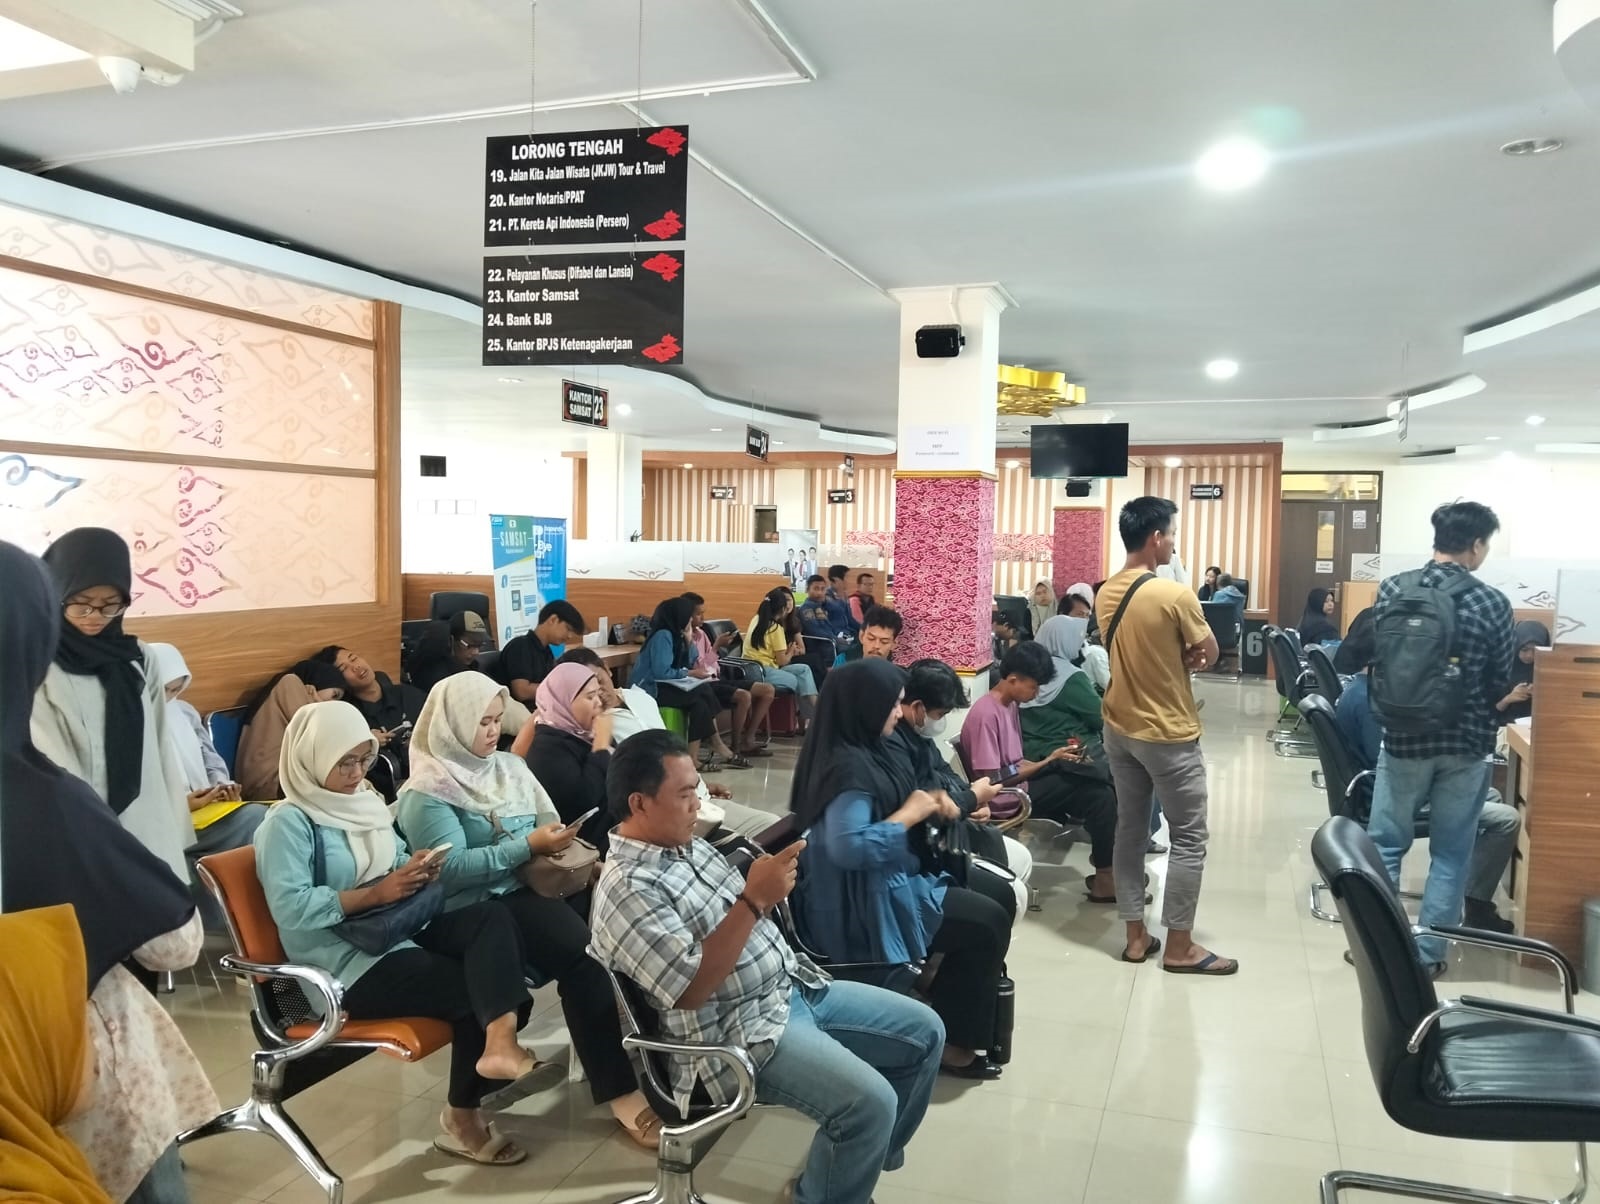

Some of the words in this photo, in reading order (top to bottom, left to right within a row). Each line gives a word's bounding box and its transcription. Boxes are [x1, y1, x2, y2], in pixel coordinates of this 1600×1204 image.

[512, 143, 565, 160] LORONG
[569, 139, 623, 157] TENGAH
[490, 169, 507, 182] 19.
[509, 168, 528, 182] Jalan
[529, 167, 544, 181] Kita
[545, 166, 564, 180] Jalan
[565, 165, 590, 179] Wisata
[591, 163, 617, 181] (JKJW)
[618, 162, 634, 176] Tour
[635, 161, 642, 175] &
[643, 160, 666, 175] Travel
[489, 194, 507, 207] 20.
[508, 193, 534, 206] Kantor
[536, 190, 585, 205] Notaris/PPAT
[489, 218, 506, 232] 21.
[508, 218, 519, 231] PT.
[520, 217, 545, 230] Kereta
[546, 216, 558, 233] Api
[559, 215, 595, 229] Indonesia
[596, 212, 629, 231] (Persero)
[487, 269, 505, 282] 22.
[506, 268, 540, 284] Pelayanan
[541, 266, 566, 280] Khusus
[567, 265, 593, 282] (Difabel
[594, 265, 607, 279] dan
[608, 264, 634, 281] Lansia)
[487, 290, 504, 303] 23.
[506, 289, 540, 303] Kantor
[541, 288, 579, 302] Samsat
[487, 313, 504, 327] 24.
[506, 313, 532, 326] Bank
[533, 312, 553, 326] BJB
[487, 338, 504, 352] 25.
[506, 338, 535, 351] Kantor
[536, 337, 559, 351] BPJS
[560, 336, 633, 353] Ketenagakerjaan
[569, 389, 592, 405] KANTOR
[569, 403, 592, 418] SAMSAT
[594, 395, 604, 420] 23
[727, 488, 734, 499] 2
[846, 491, 853, 502] 3
[1213, 487, 1221, 497] 6
[500, 531, 527, 547] SAMSAT
[1246, 631, 1263, 657] 6
